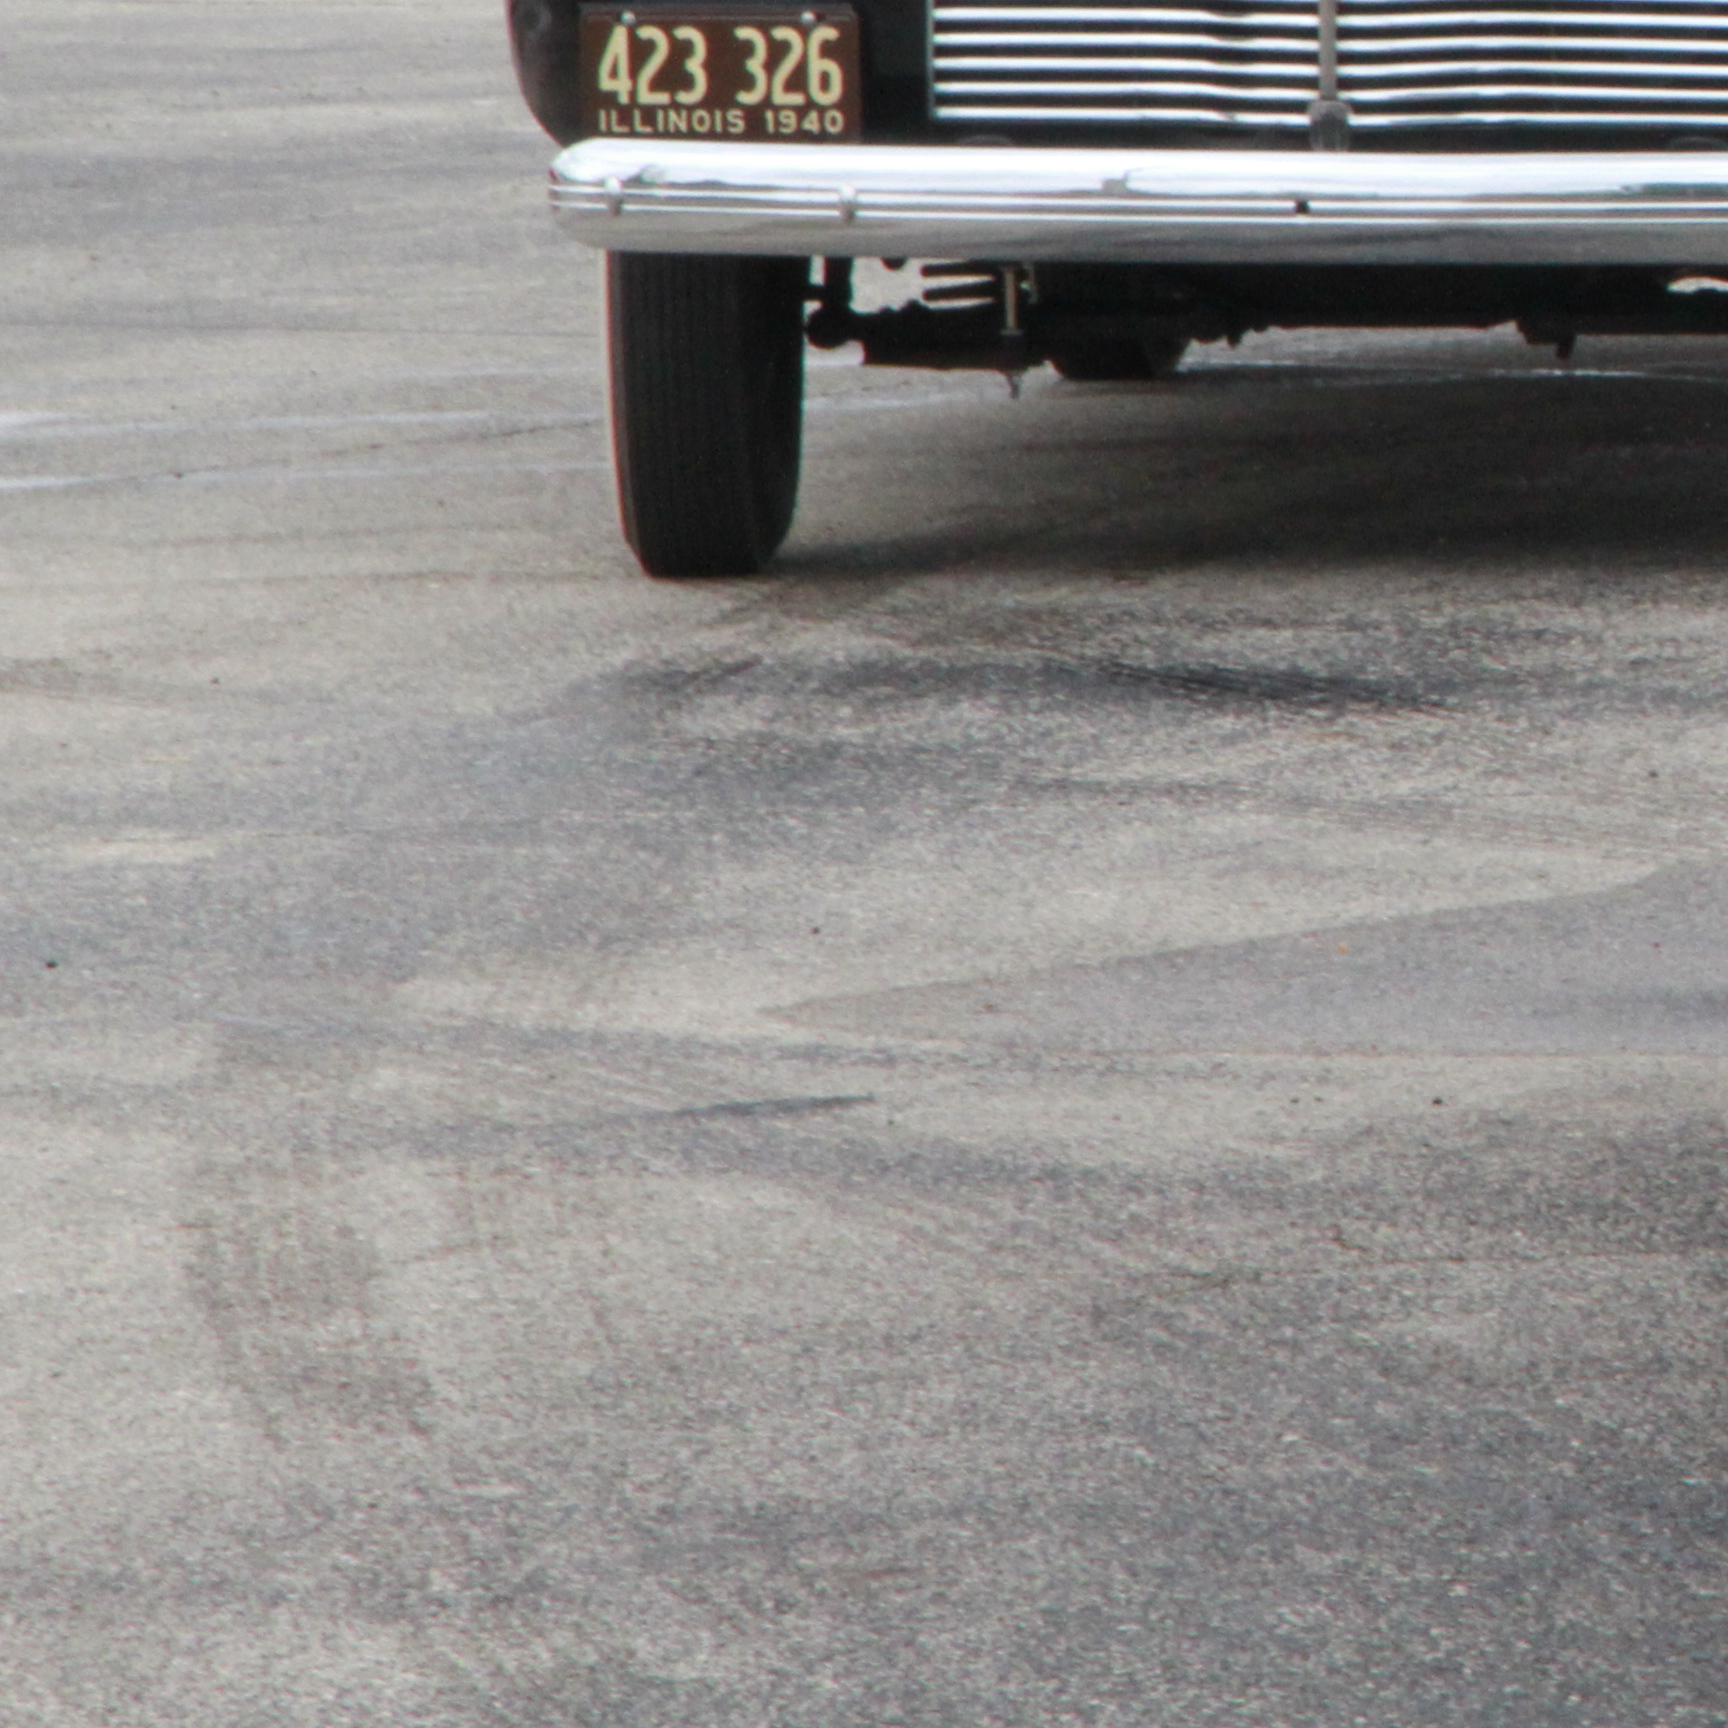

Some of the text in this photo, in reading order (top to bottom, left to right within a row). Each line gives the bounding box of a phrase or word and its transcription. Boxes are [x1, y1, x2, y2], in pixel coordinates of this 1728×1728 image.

[598, 25, 844, 106] 423 326
[599, 108, 845, 135] ILLINOIS 1940
